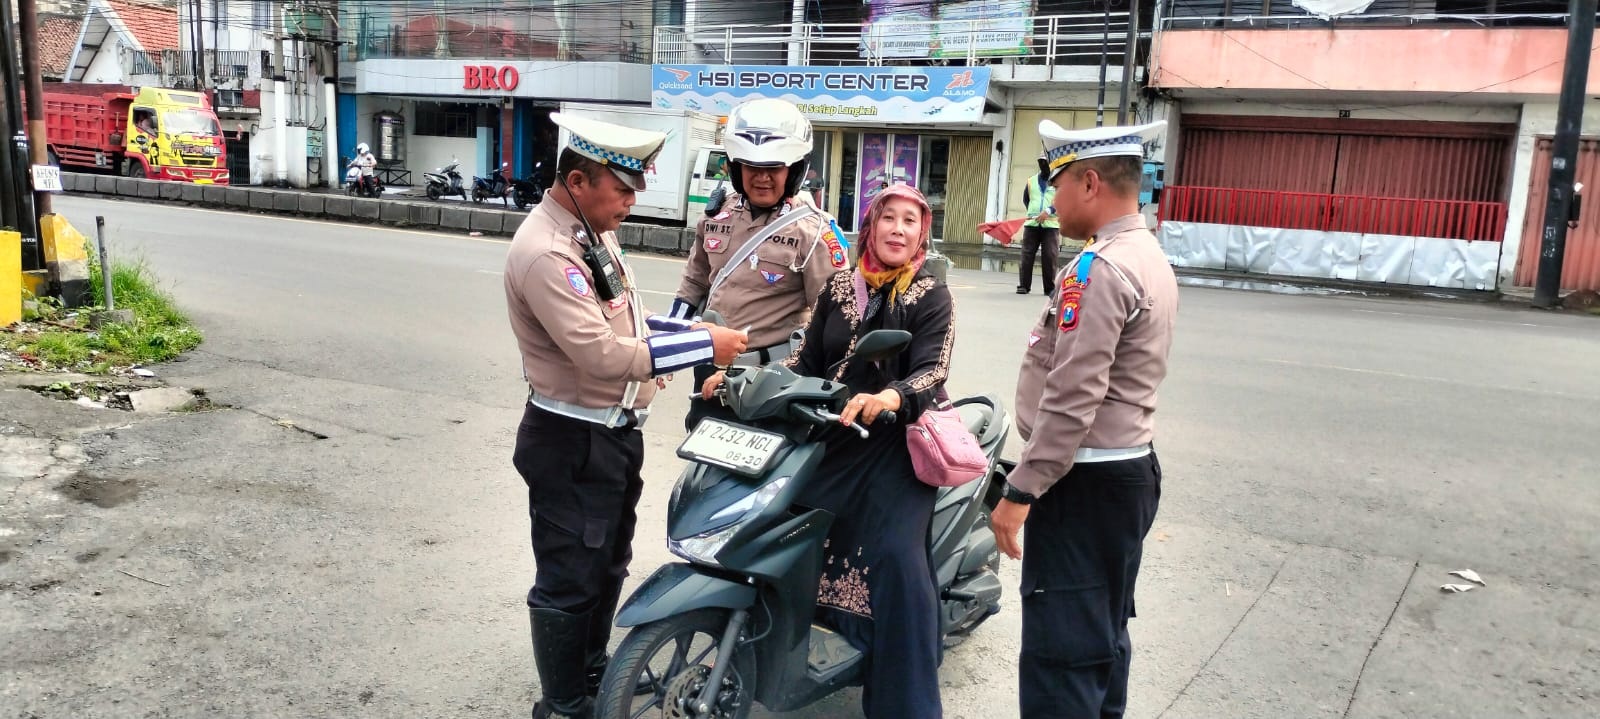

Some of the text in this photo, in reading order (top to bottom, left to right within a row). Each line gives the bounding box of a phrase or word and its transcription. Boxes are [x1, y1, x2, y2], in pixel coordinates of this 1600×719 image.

[463, 65, 519, 91] BRO
[698, 72, 929, 91] HSI SPORT CENTER
[658, 81, 693, 90] Quicksand
[808, 103, 837, 116] Setiap
[838, 104, 878, 117] Langkah
[705, 223, 719, 233] DWI
[766, 234, 799, 248] OLRI
[697, 424, 773, 453] W 2432 NGL
